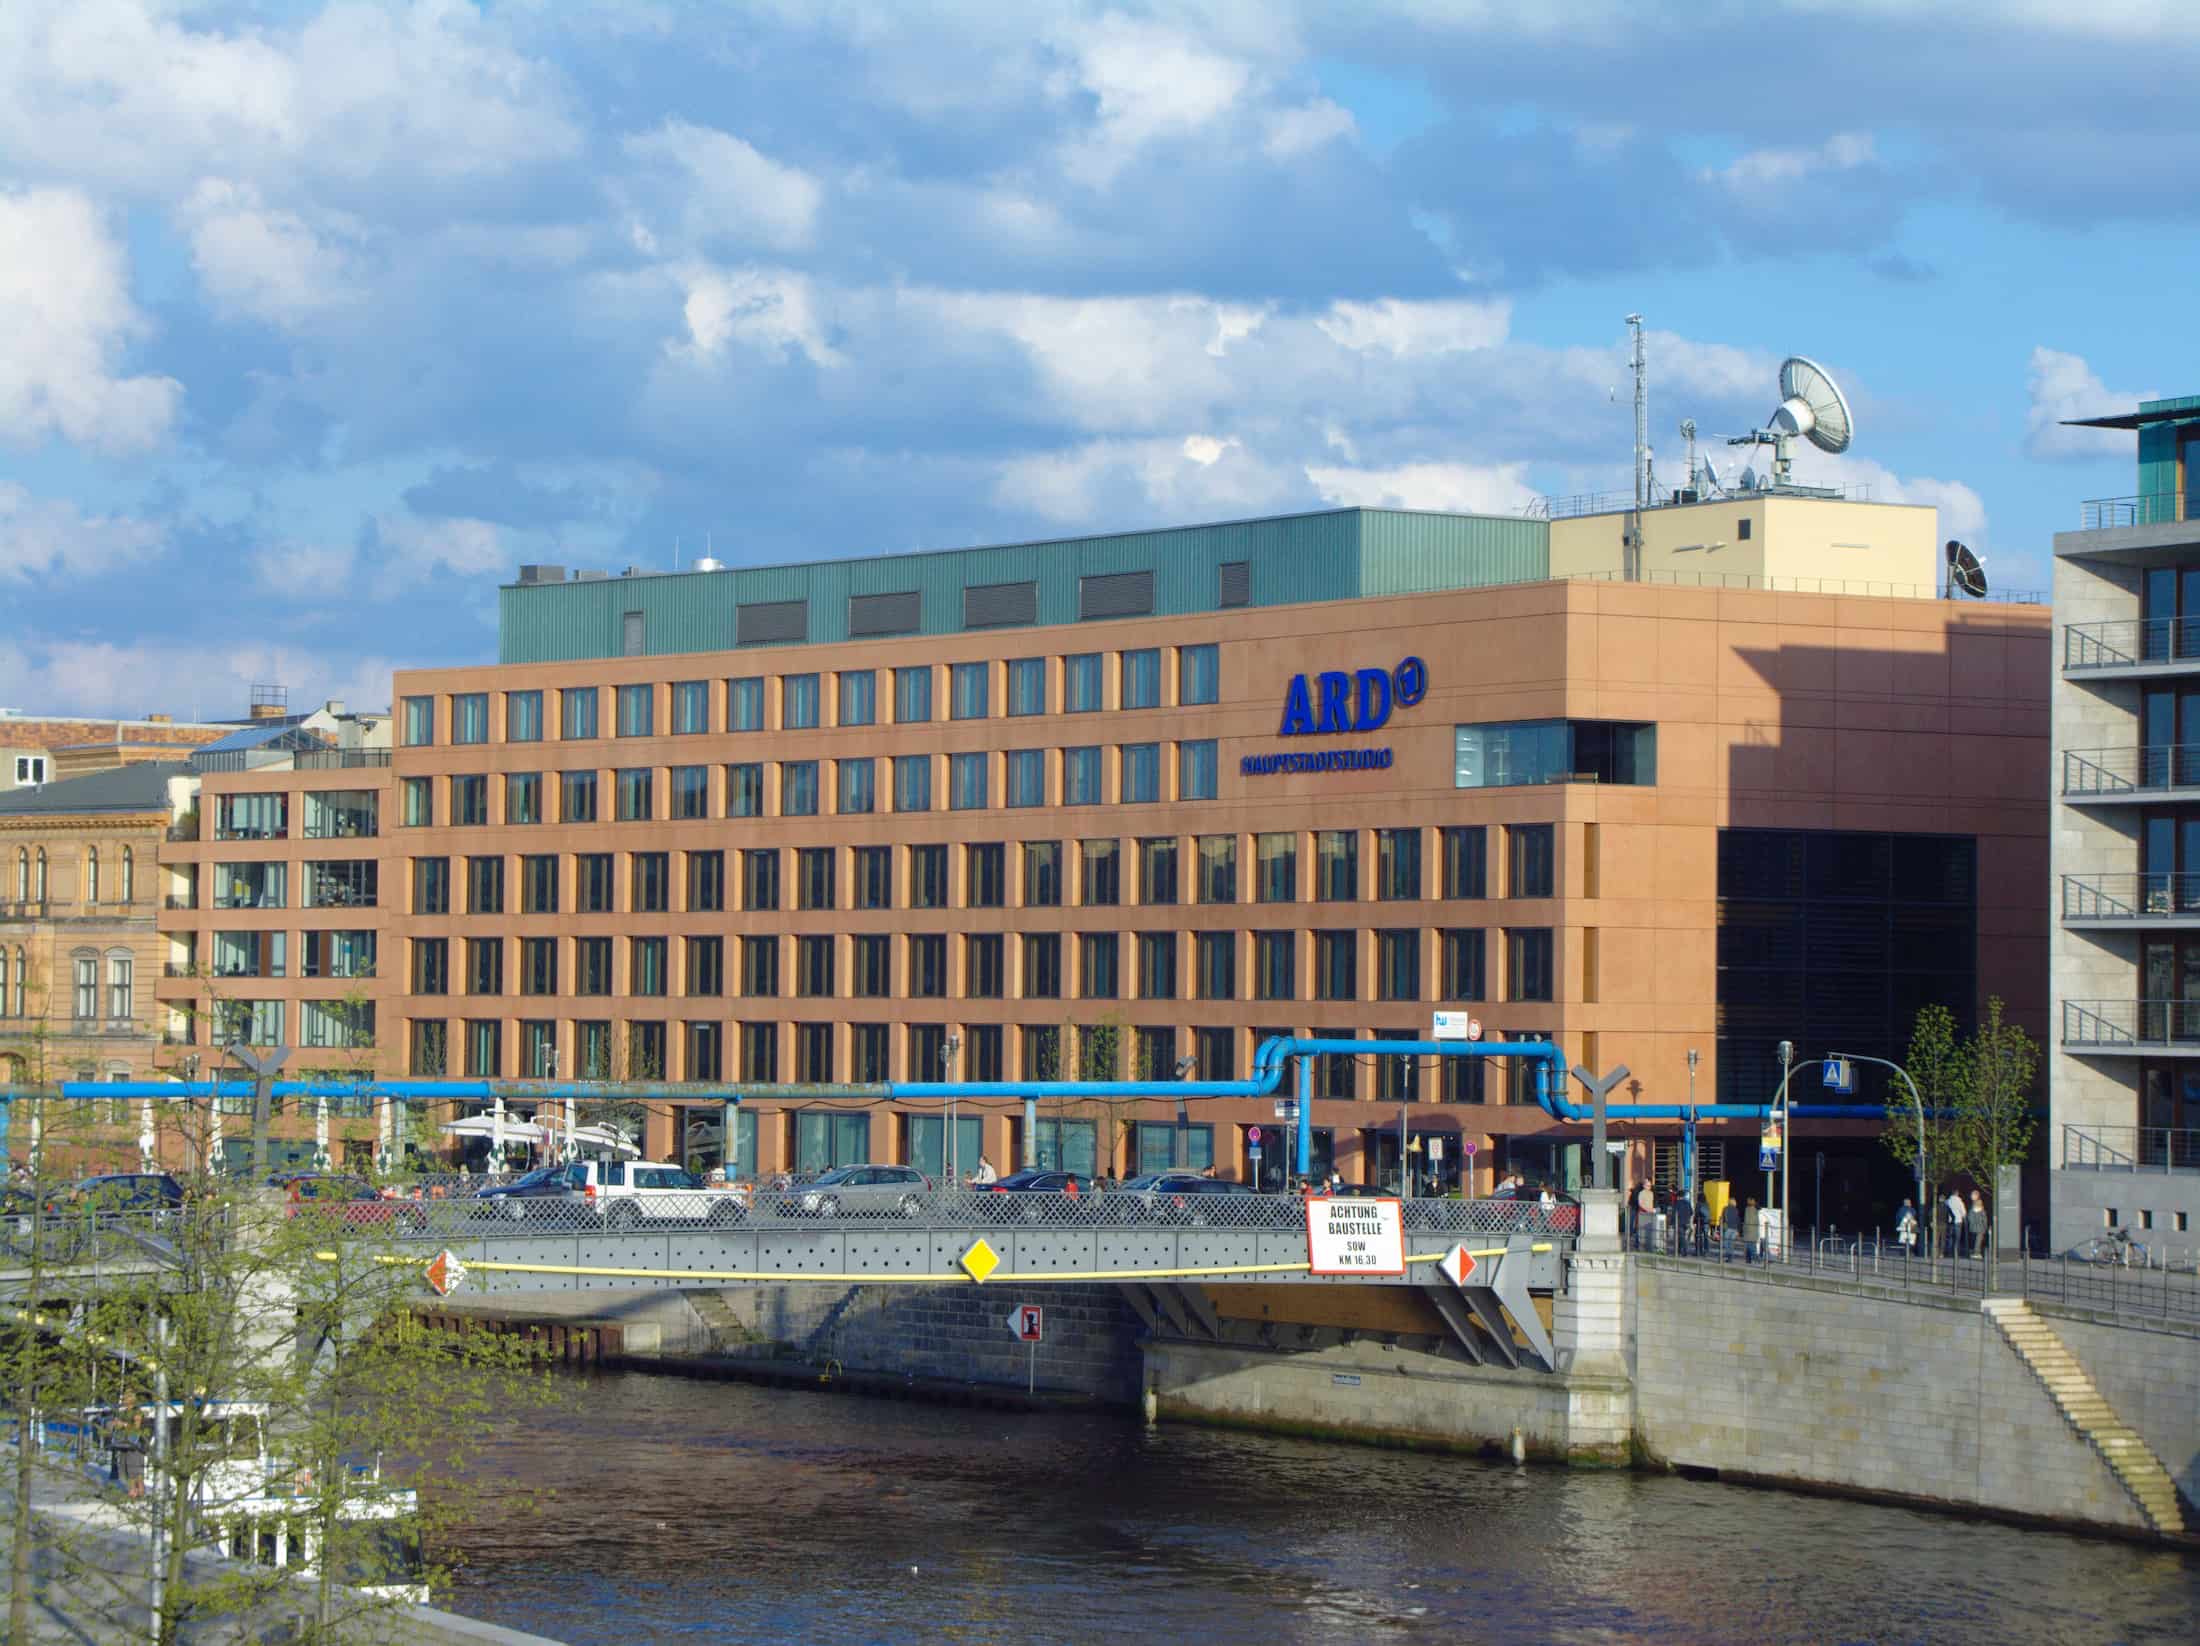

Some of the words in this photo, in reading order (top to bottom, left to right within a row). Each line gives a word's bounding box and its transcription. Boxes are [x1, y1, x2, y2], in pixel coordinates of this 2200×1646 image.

[1280, 668, 1393, 736] ARD
[1330, 1205, 1377, 1218] ACHTUNG
[1328, 1222, 1383, 1235] BAUSTELLE
[1346, 1241, 1366, 1252] SOW
[1338, 1255, 1352, 1265] KM
